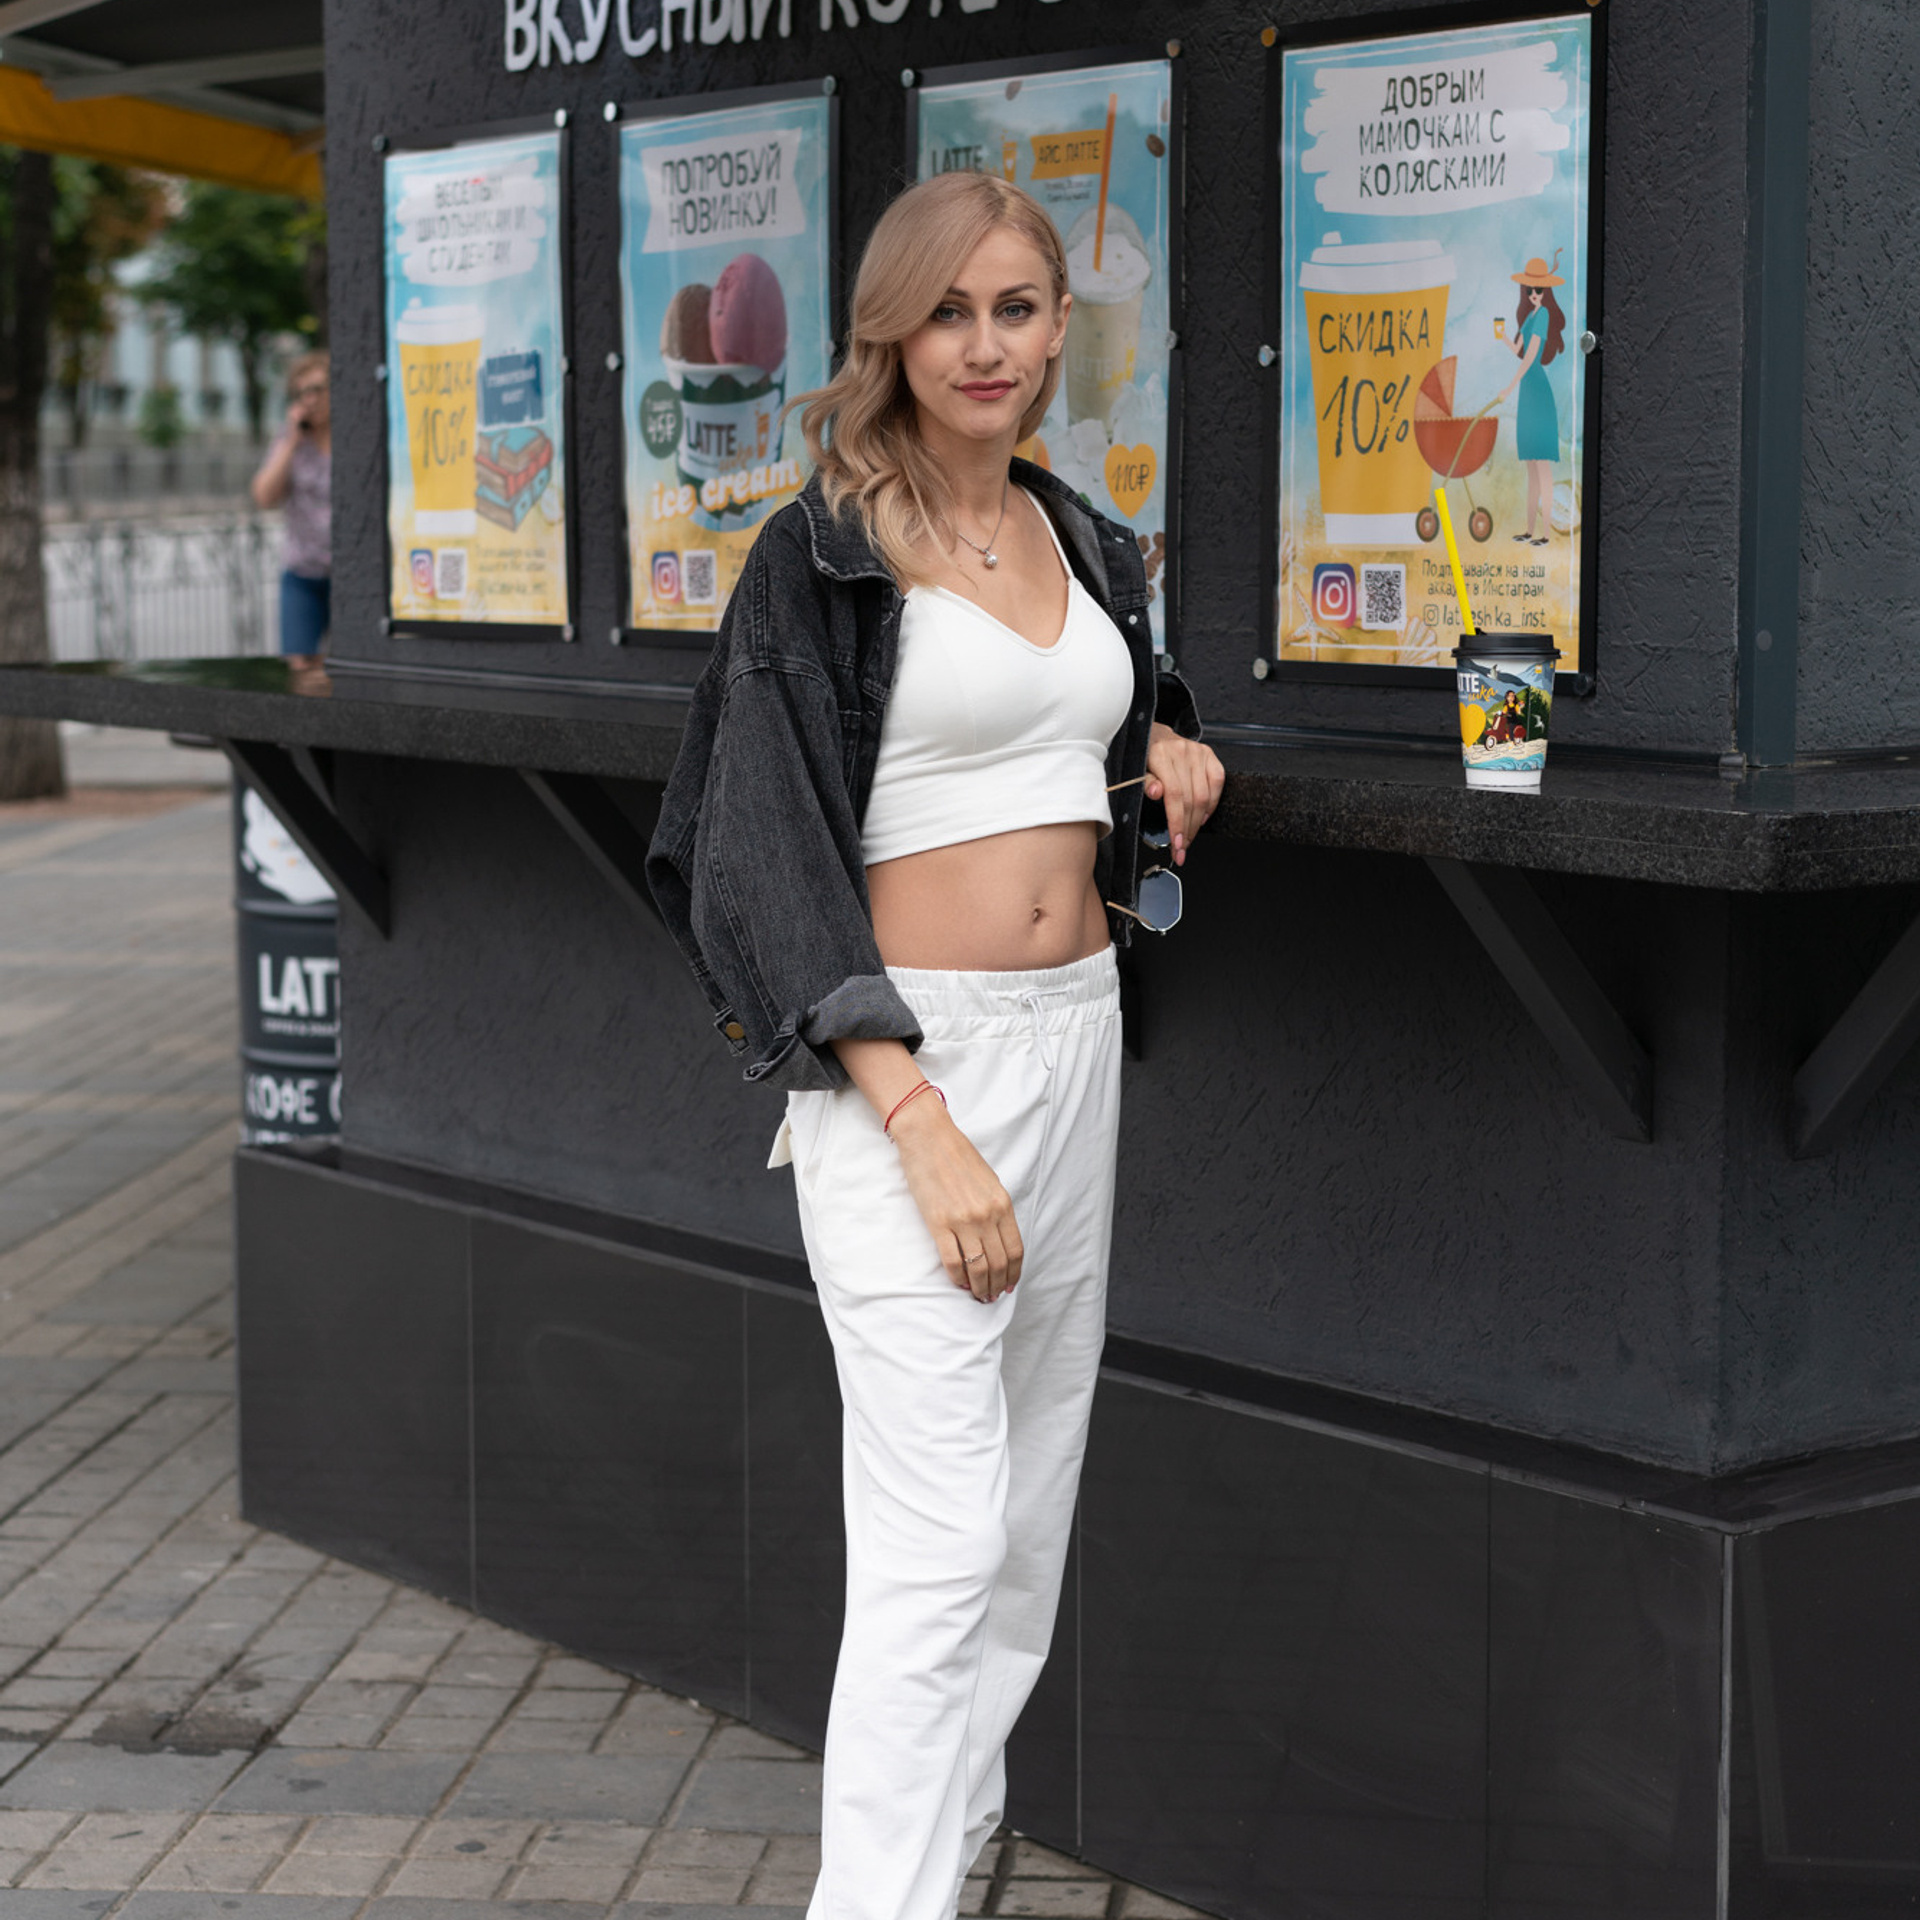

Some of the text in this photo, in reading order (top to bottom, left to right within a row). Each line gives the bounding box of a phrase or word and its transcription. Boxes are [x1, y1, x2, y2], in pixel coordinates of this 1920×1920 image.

[1381, 67, 1485, 116] ДОБРЫМ
[1359, 109, 1506, 156] МАМОЧКАМ С
[662, 141, 782, 197] ПОПРОБУЙ
[1360, 152, 1506, 198] КОЛЯСКАМИ
[669, 186, 777, 238] НОВИНКУ!
[1319, 307, 1431, 358] СКИДКА
[407, 360, 473, 397] СКИДКА
[416, 404, 467, 470] 10%
[686, 416, 737, 458] LATTE
[1322, 373, 1411, 459] 10%
[651, 457, 802, 523] ice cream
[1422, 559, 1545, 578] Подпывайся на наш
[1428, 581, 1471, 598] аккаут
[1482, 578, 1544, 600] Инстаграм
[1443, 603, 1547, 628] lateshka_inst
[258, 953, 340, 1017] LAT
